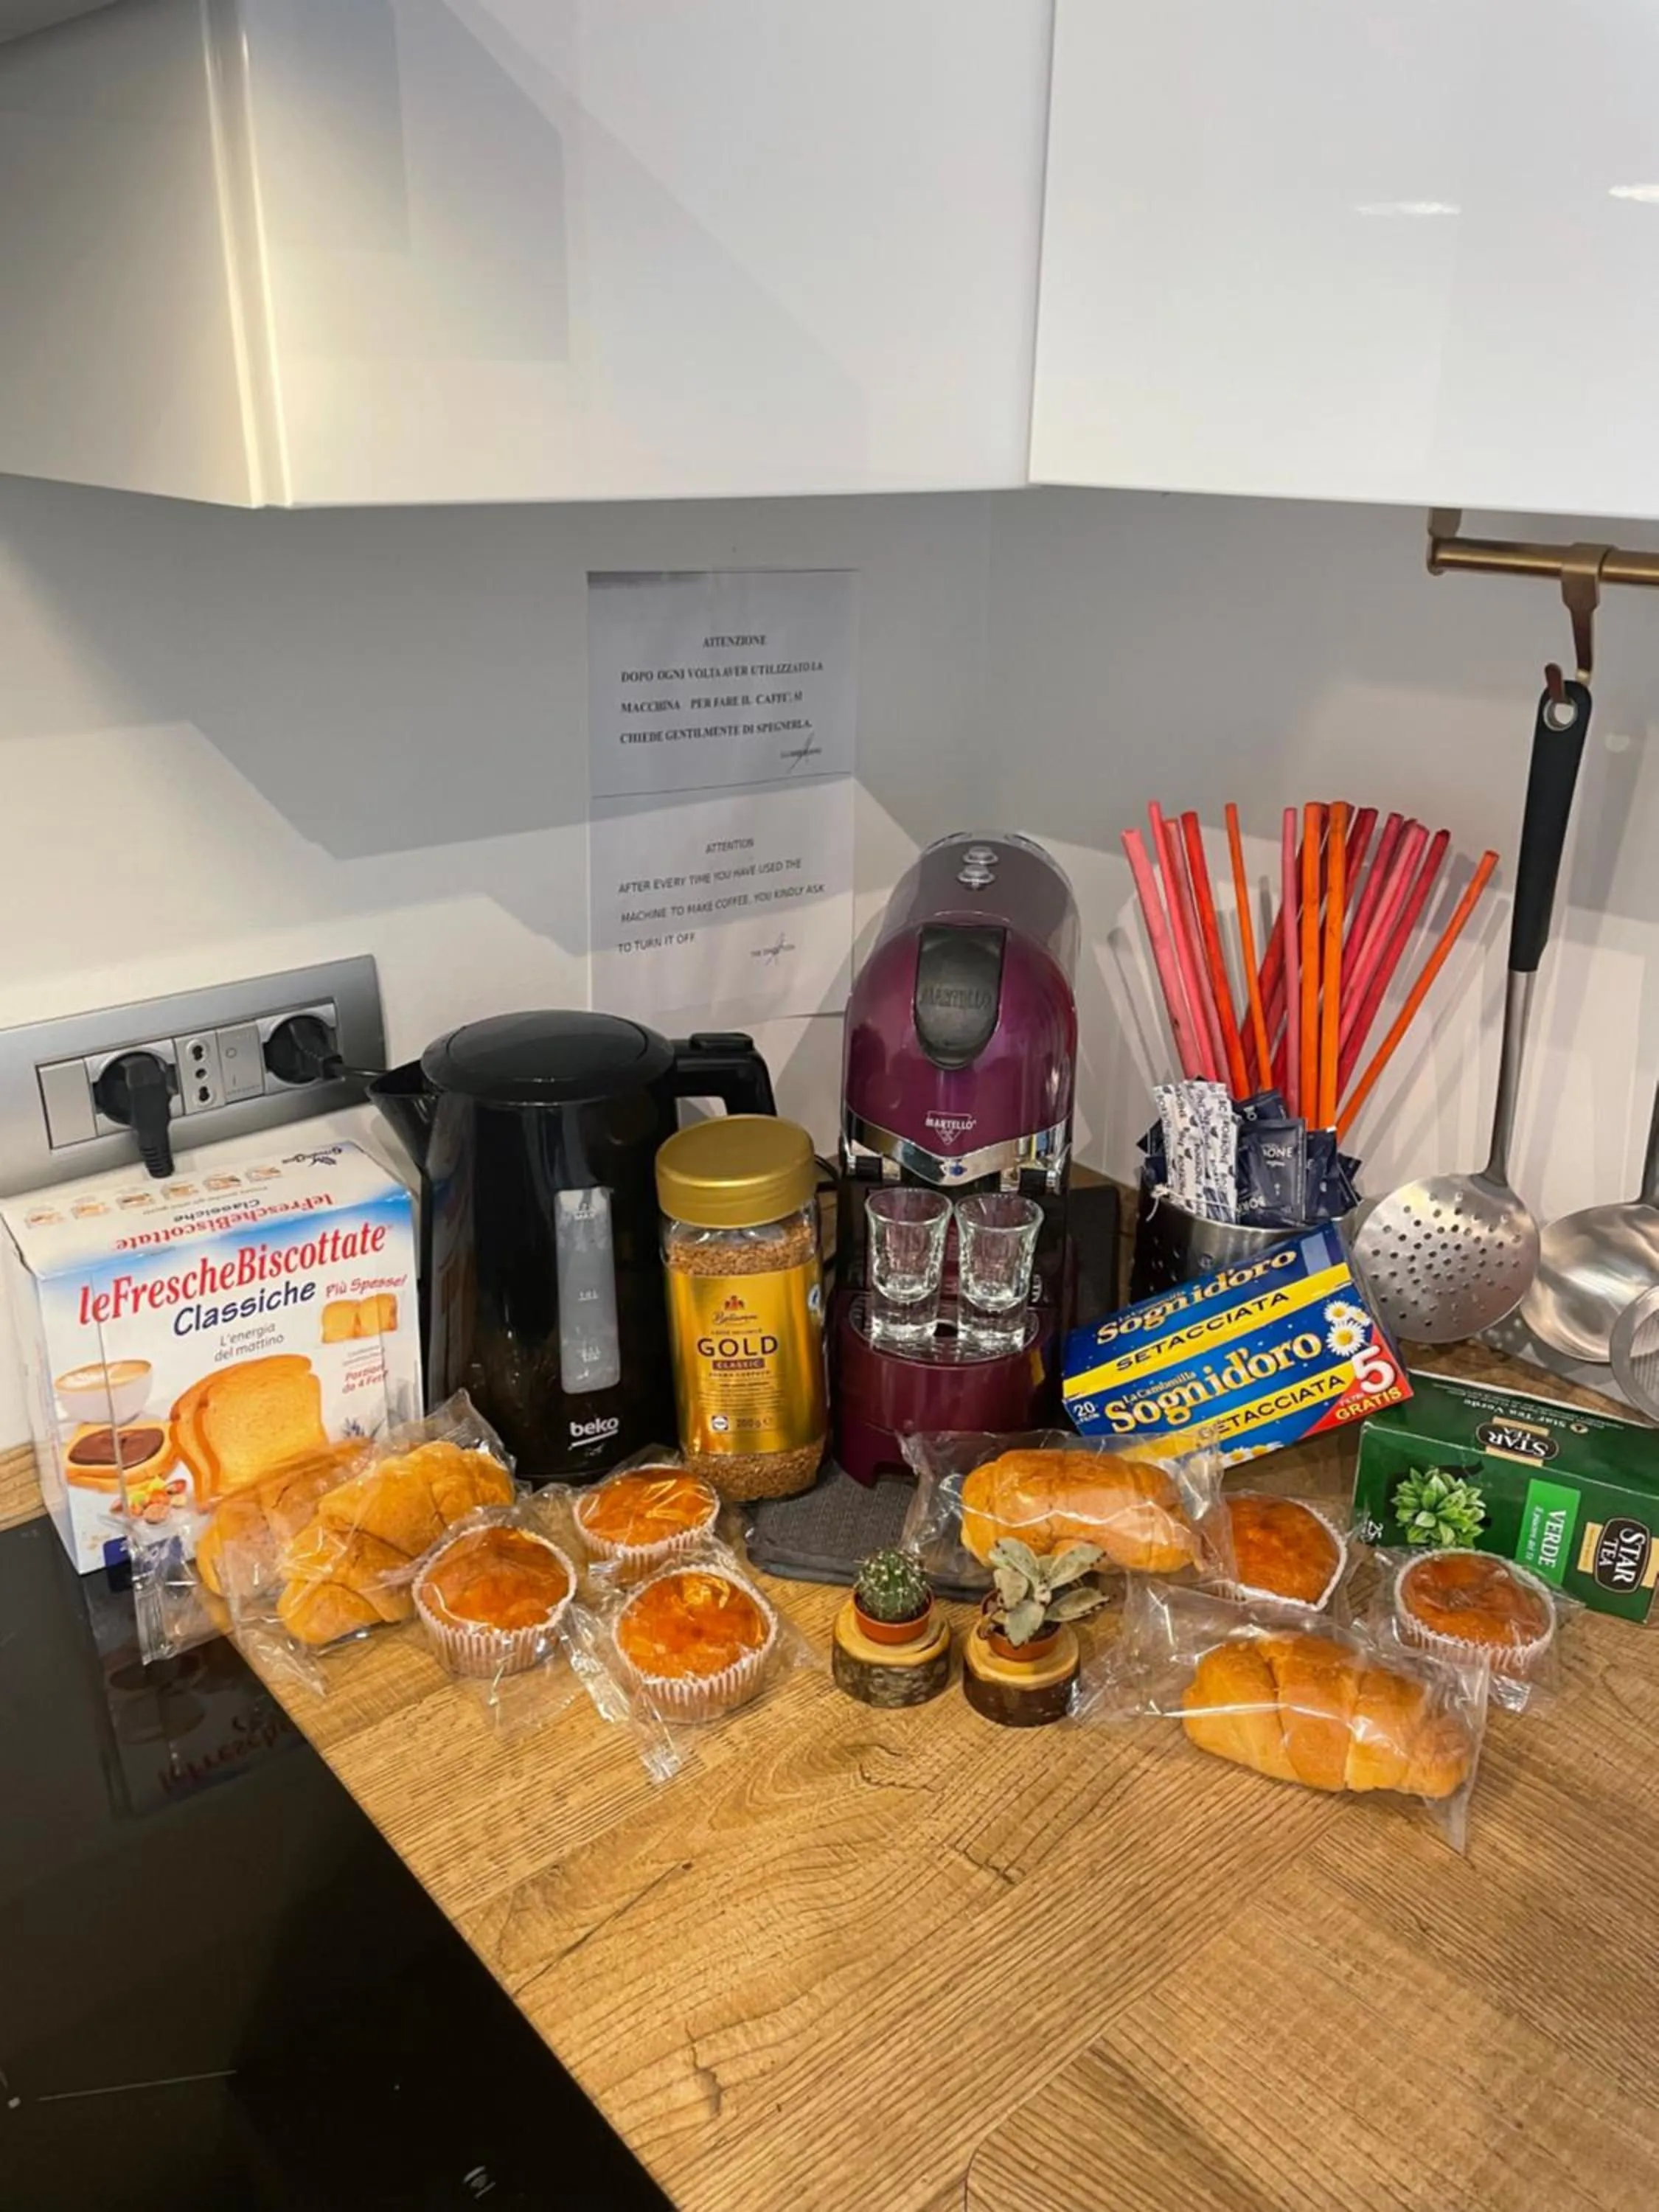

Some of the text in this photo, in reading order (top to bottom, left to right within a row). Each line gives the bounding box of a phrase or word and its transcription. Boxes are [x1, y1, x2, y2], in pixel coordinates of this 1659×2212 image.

[703, 635, 766, 648] ATTENZIONE
[621, 670, 653, 683] DOPO
[657, 669, 685, 680] OGNI
[751, 663, 810, 676] UTILIZZATO
[621, 700, 681, 713] MACCHINA
[691, 698, 712, 709] PER
[713, 695, 738, 709] FARE
[741, 695, 751, 706] IL
[619, 731, 664, 744] CHIEDE
[665, 725, 740, 741] GENTILMENTE
[742, 724, 754, 735] DI
[705, 838, 754, 854] ATTENTION
[619, 858, 801, 893] AFTER EVERY TIME YOU HAVE USED THE
[621, 908, 666, 922] MACHINE
[671, 905, 684, 916] TO
[687, 900, 713, 914] MAKE
[754, 891, 772, 903] YOU
[774, 886, 804, 899] KINDLY
[805, 884, 825, 894] ASK
[618, 932, 695, 953] TO TURN IT OFF
[925, 1117, 973, 1130] MARTELLO
[78, 1220, 387, 1326] leFrescheBiscottate
[325, 1274, 407, 1298] Più Spesse!
[173, 1279, 316, 1336] Classiche
[220, 1323, 276, 1346] L'energia
[1116, 1292, 1290, 1371] SETACCIATA
[214, 1333, 285, 1363] del mattino
[697, 1335, 779, 1357] GOLD
[1352, 1345, 1395, 1394] 5
[342, 1382, 356, 1394] da
[1074, 1401, 1096, 1418] 20
[1335, 1386, 1402, 1421] GRATIS
[1463, 1399, 1504, 1415] Verde
[1508, 1409, 1534, 1421] Tea
[1539, 1416, 1567, 1429] Star
[569, 1418, 619, 1438] beko
[1503, 1427, 1532, 1441] TEA
[1487, 1430, 1549, 1458] STAR
[1537, 1510, 1567, 1569] VERDE
[1599, 1538, 1620, 1567] TEA
[1613, 1527, 1646, 1584] STAR
